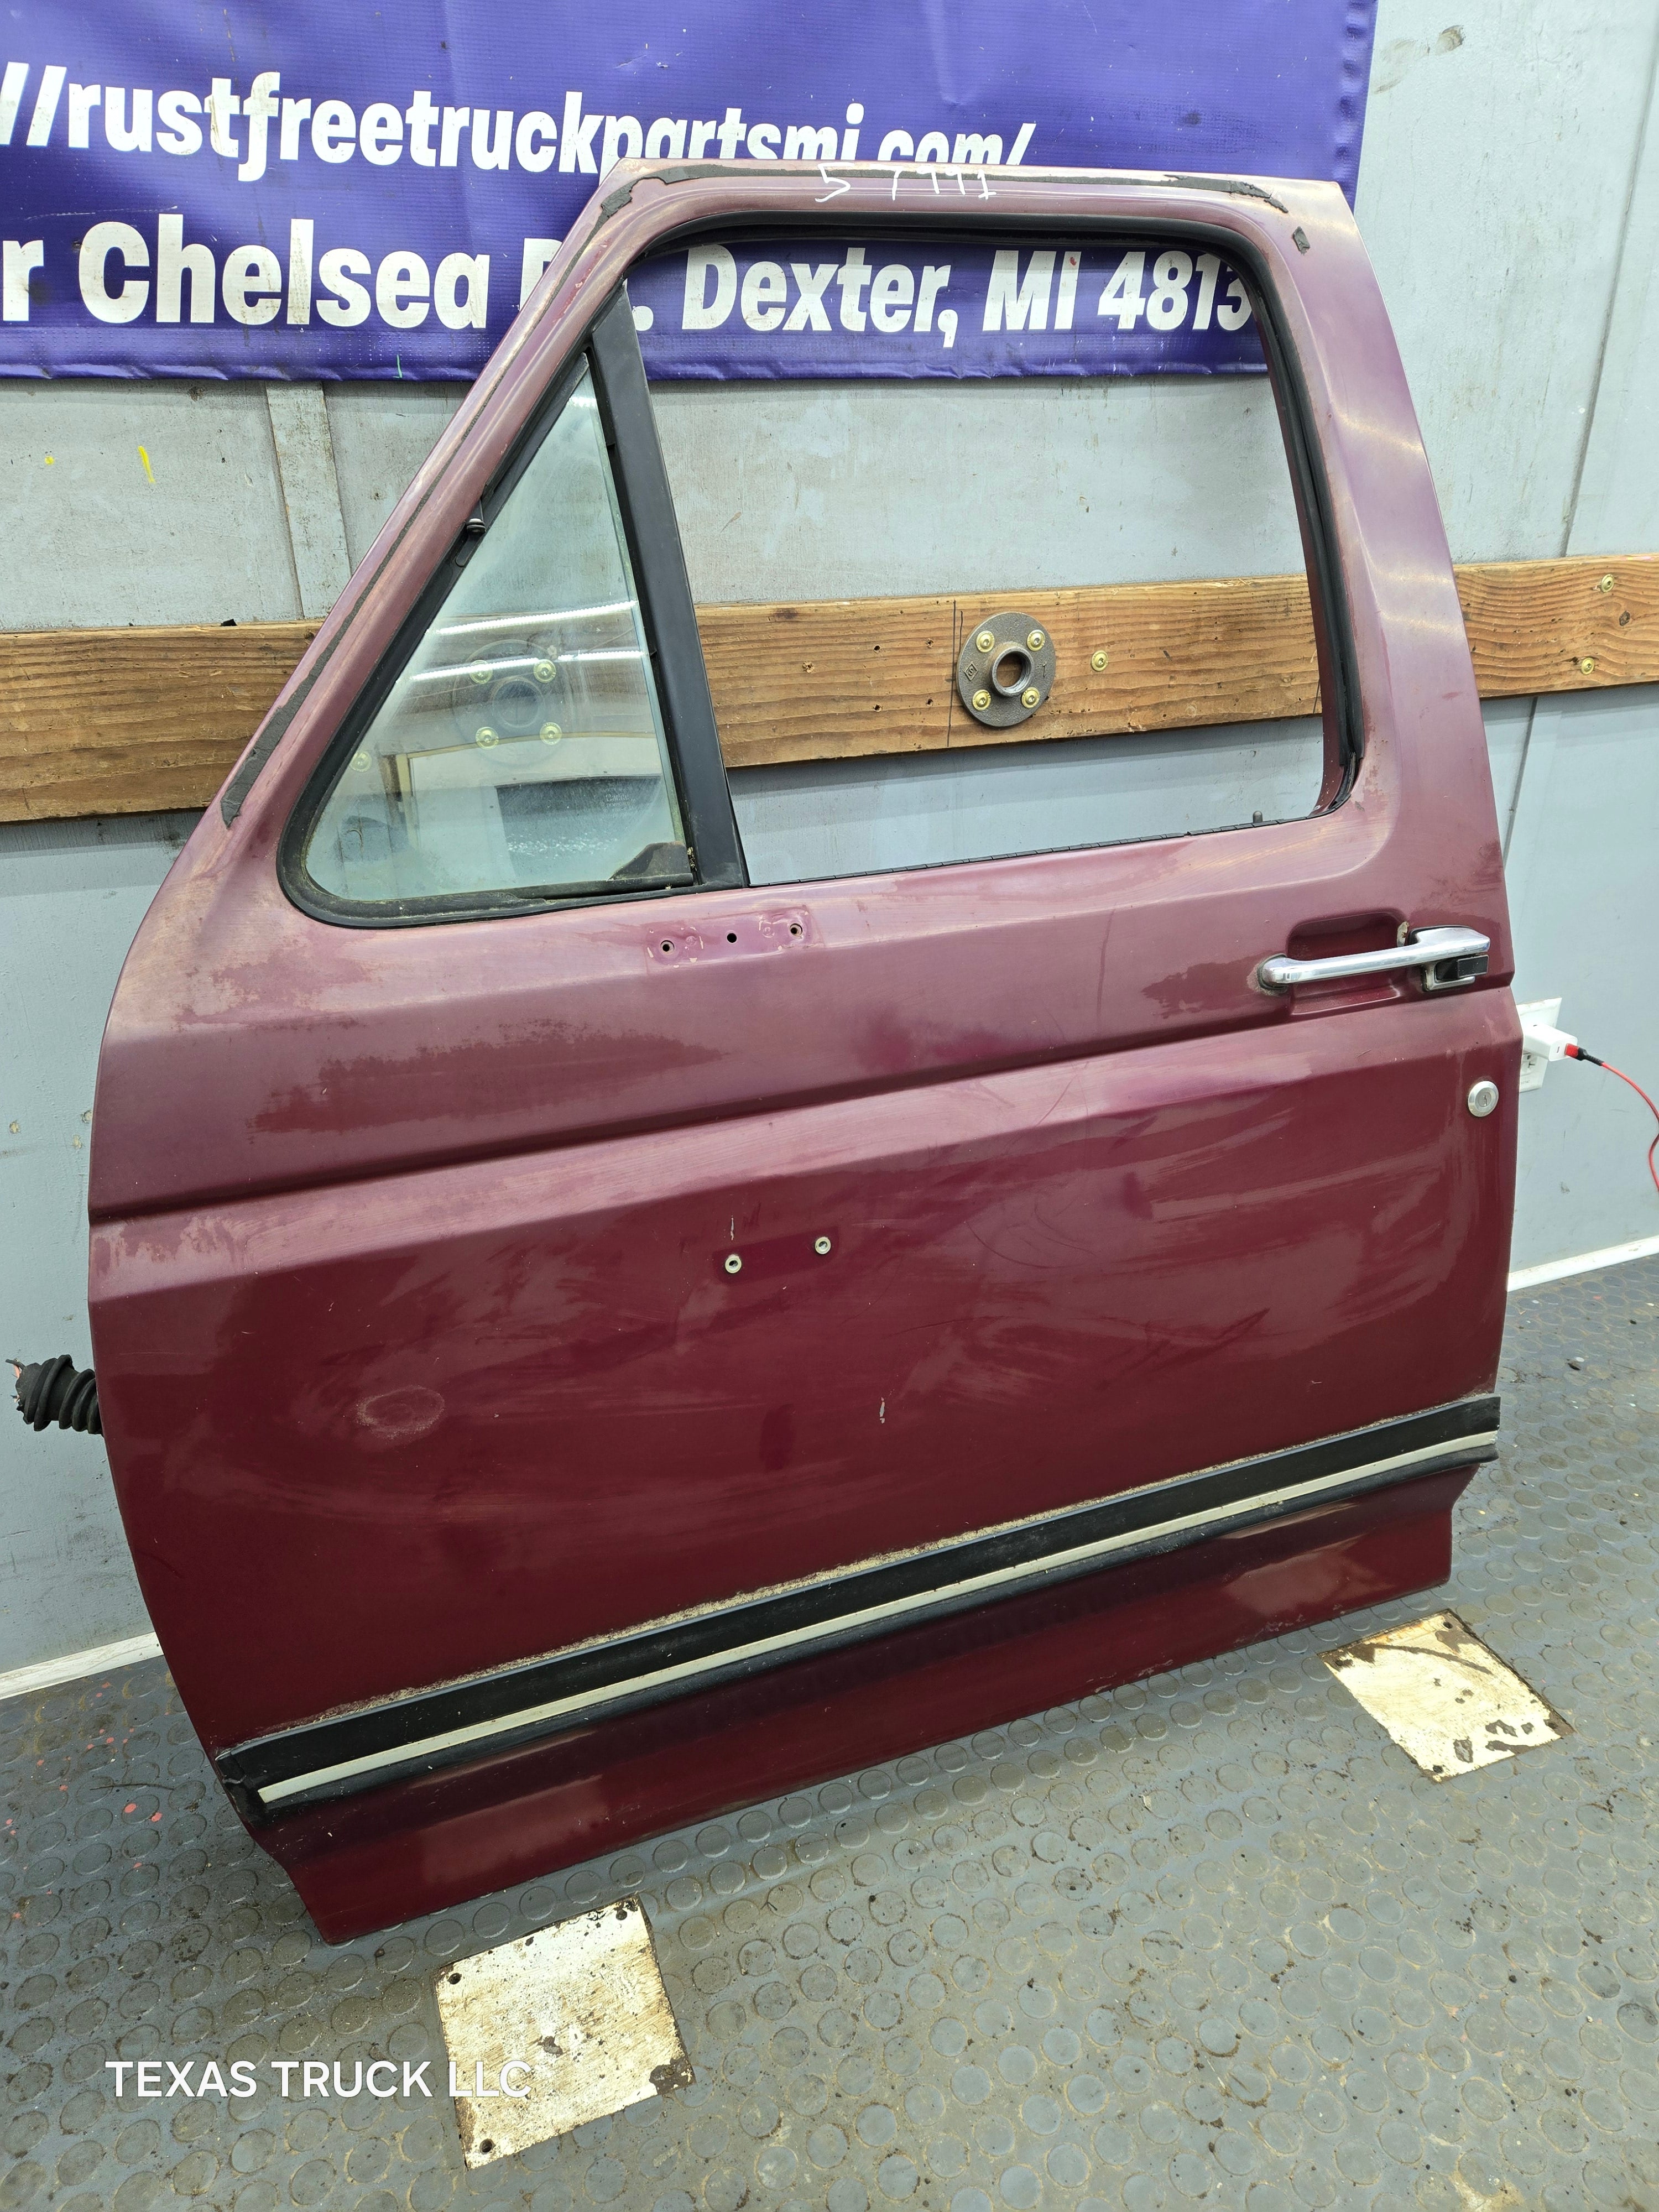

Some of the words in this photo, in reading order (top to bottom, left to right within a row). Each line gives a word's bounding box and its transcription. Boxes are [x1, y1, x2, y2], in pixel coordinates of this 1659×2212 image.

[0, 61, 1037, 181] //rustfreetruckpartsmicom/
[79, 213, 491, 329] Chelsea
[681, 244, 959, 348] Dexter,
[982, 250, 1082, 331] MI
